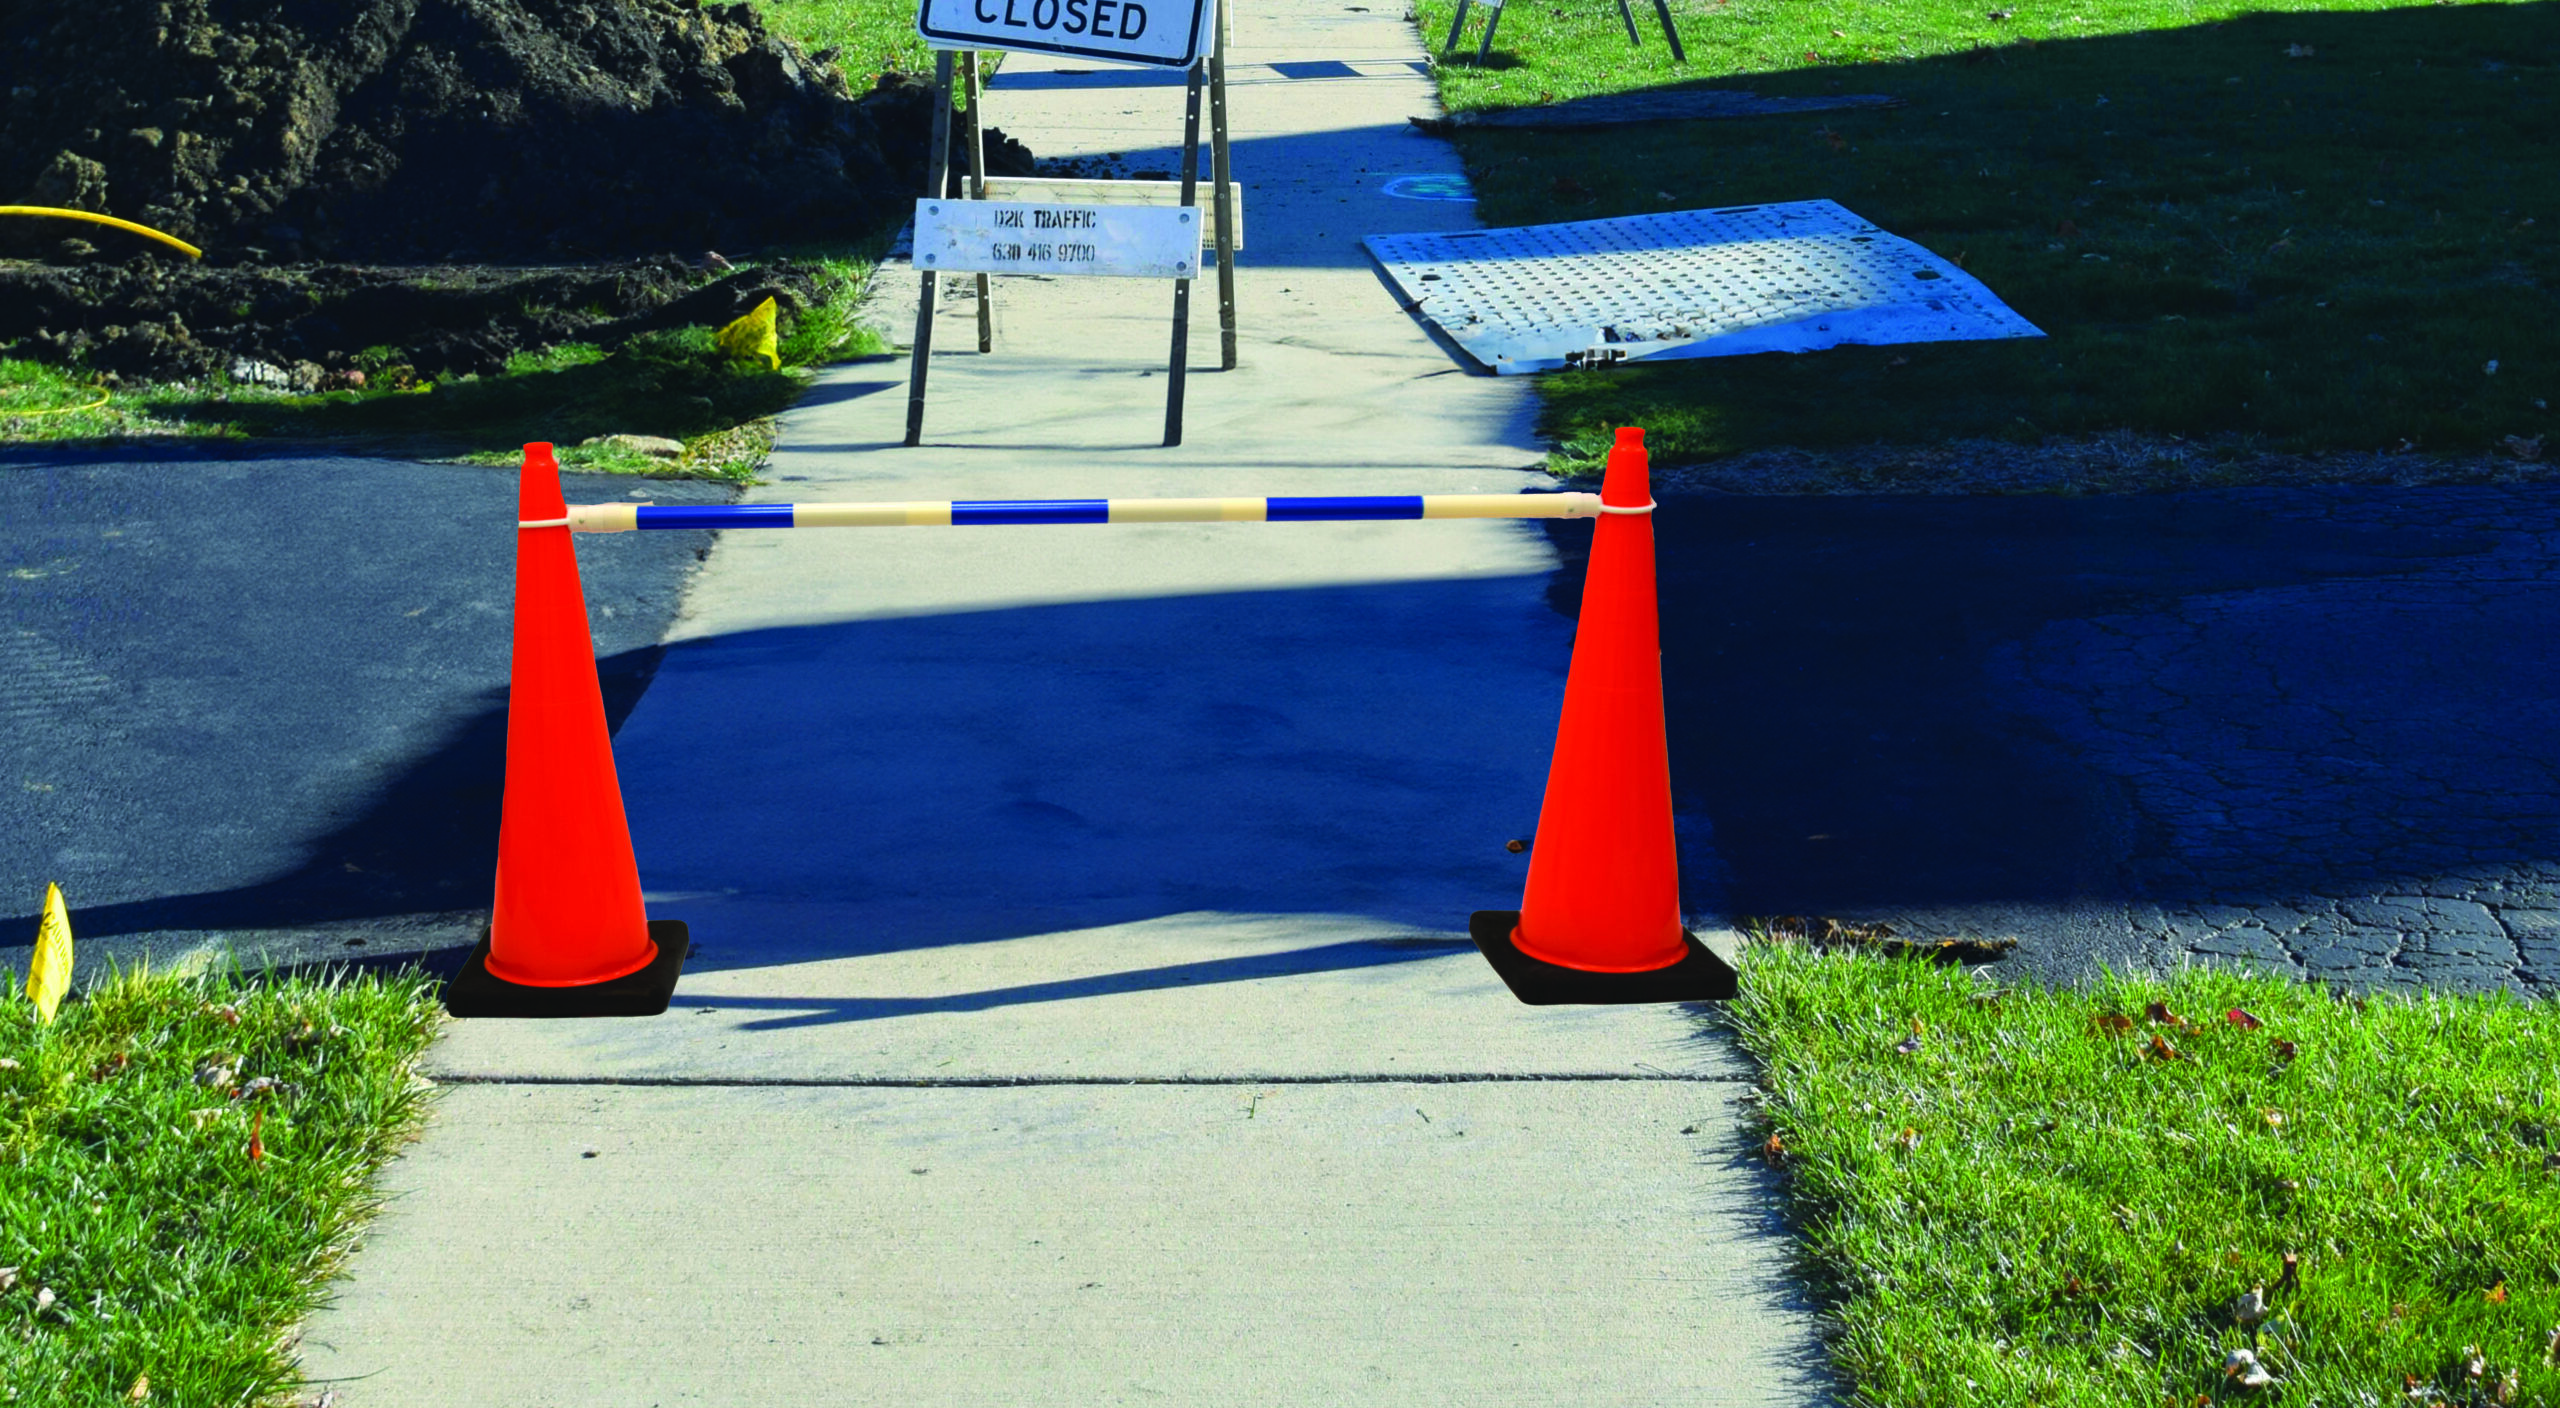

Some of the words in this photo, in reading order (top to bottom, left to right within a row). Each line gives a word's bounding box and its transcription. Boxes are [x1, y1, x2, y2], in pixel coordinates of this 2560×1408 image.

[974, 0, 1147, 40] CLOSED
[994, 209, 1024, 228] D2K
[1033, 210, 1097, 228] TRAFFIC
[992, 243, 1021, 260] 630
[1027, 243, 1051, 261] 416
[1058, 244, 1096, 262] 9700
